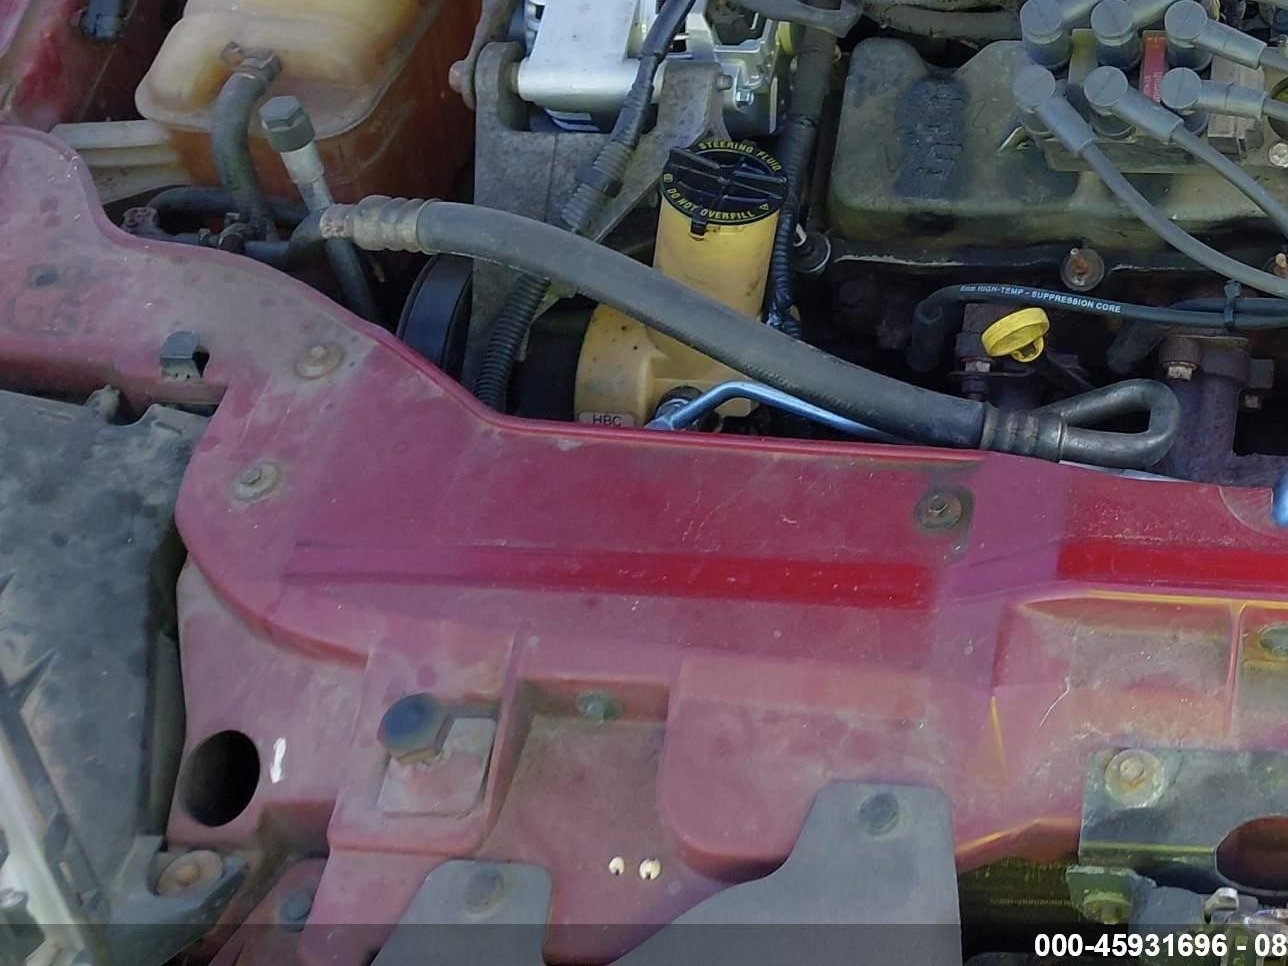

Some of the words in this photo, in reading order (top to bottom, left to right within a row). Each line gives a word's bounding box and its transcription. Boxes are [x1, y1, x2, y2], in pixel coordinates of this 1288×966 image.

[698, 140, 754, 154] STEERING
[756, 150, 783, 172] FLUID
[666, 187, 679, 200] DO
[678, 197, 700, 213] NOT
[700, 208, 755, 221] OVERFILL
[1031, 290, 1094, 308] SUPPRESSION
[1095, 302, 1122, 314] CORE
[591, 413, 623, 427] HBC
